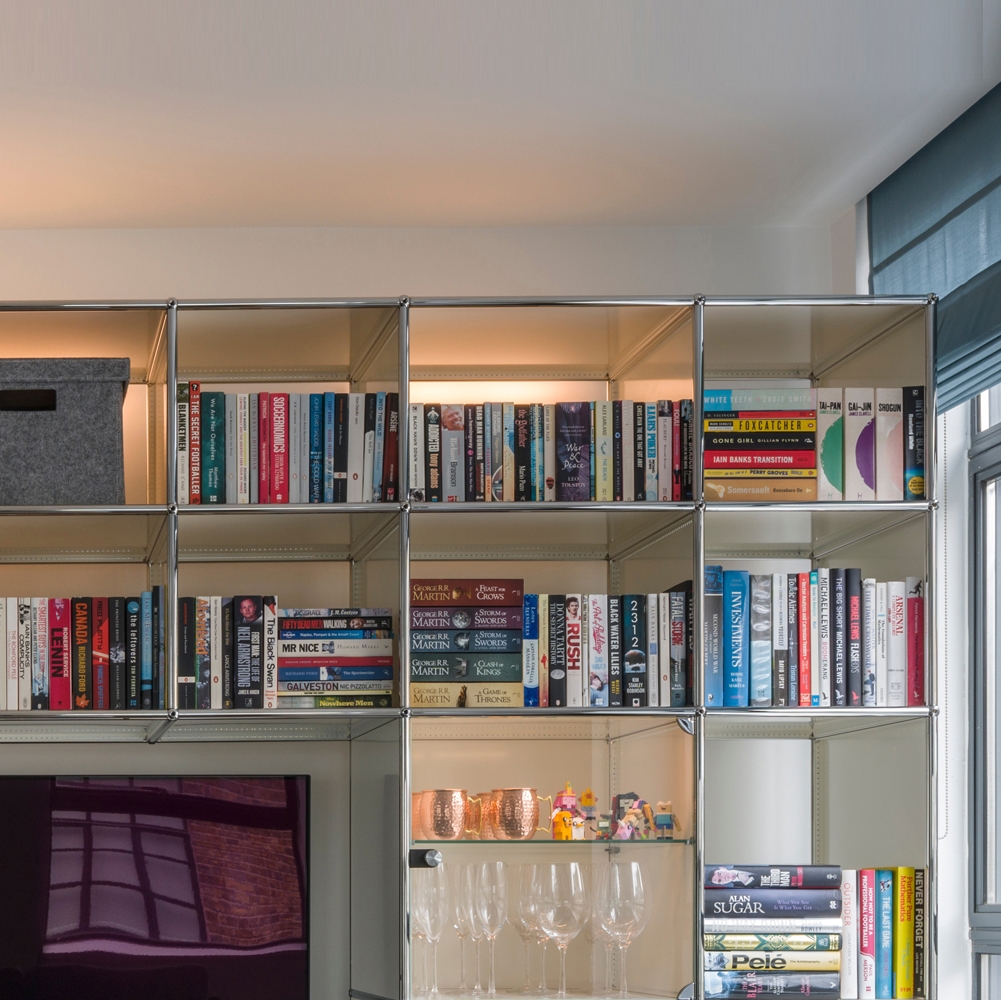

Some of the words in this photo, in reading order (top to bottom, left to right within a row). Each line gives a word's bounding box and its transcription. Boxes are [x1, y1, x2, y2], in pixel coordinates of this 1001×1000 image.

[191, 401, 199, 416] THE
[210, 398, 215, 408] We
[191, 416, 199, 446] SECRET
[273, 397, 285, 453] SOCCERNOMICS
[739, 420, 802, 430] FOXCATCHER
[429, 424, 439, 452] ADDICTED
[565, 443, 583, 452] War
[429, 453, 439, 467] tony
[564, 460, 585, 471] Peace
[753, 456, 793, 464] TRANSITION
[430, 468, 439, 489] adams
[450, 462, 458, 487] Branson
[518, 465, 526, 479] Mario
[727, 485, 770, 494] Somersault
[610, 599, 618, 623] BLACK
[895, 595, 903, 636] ARSENAL
[75, 603, 88, 644] CANADA
[237, 627, 250, 641] NEIL
[267, 618, 275, 635] The
[731, 591, 742, 667] INVESTMENTS
[267, 637, 275, 660] Black
[282, 644, 297, 653] MR
[299, 643, 319, 652] NICE
[568, 623, 580, 670] RUSH
[610, 624, 619, 650] WATER
[51, 628, 63, 678] LENIN
[78, 646, 86, 673] RICHARD
[611, 651, 619, 675] LILIES
[237, 643, 250, 687] ARMSTRONG
[267, 663, 275, 688] Swan
[78, 674, 86, 692] FORD
[713, 902, 765, 915] SUGAR
[899, 875, 907, 922] Mathematics
[915, 908, 923, 948] FORGET
[731, 954, 787, 970] Pelé
